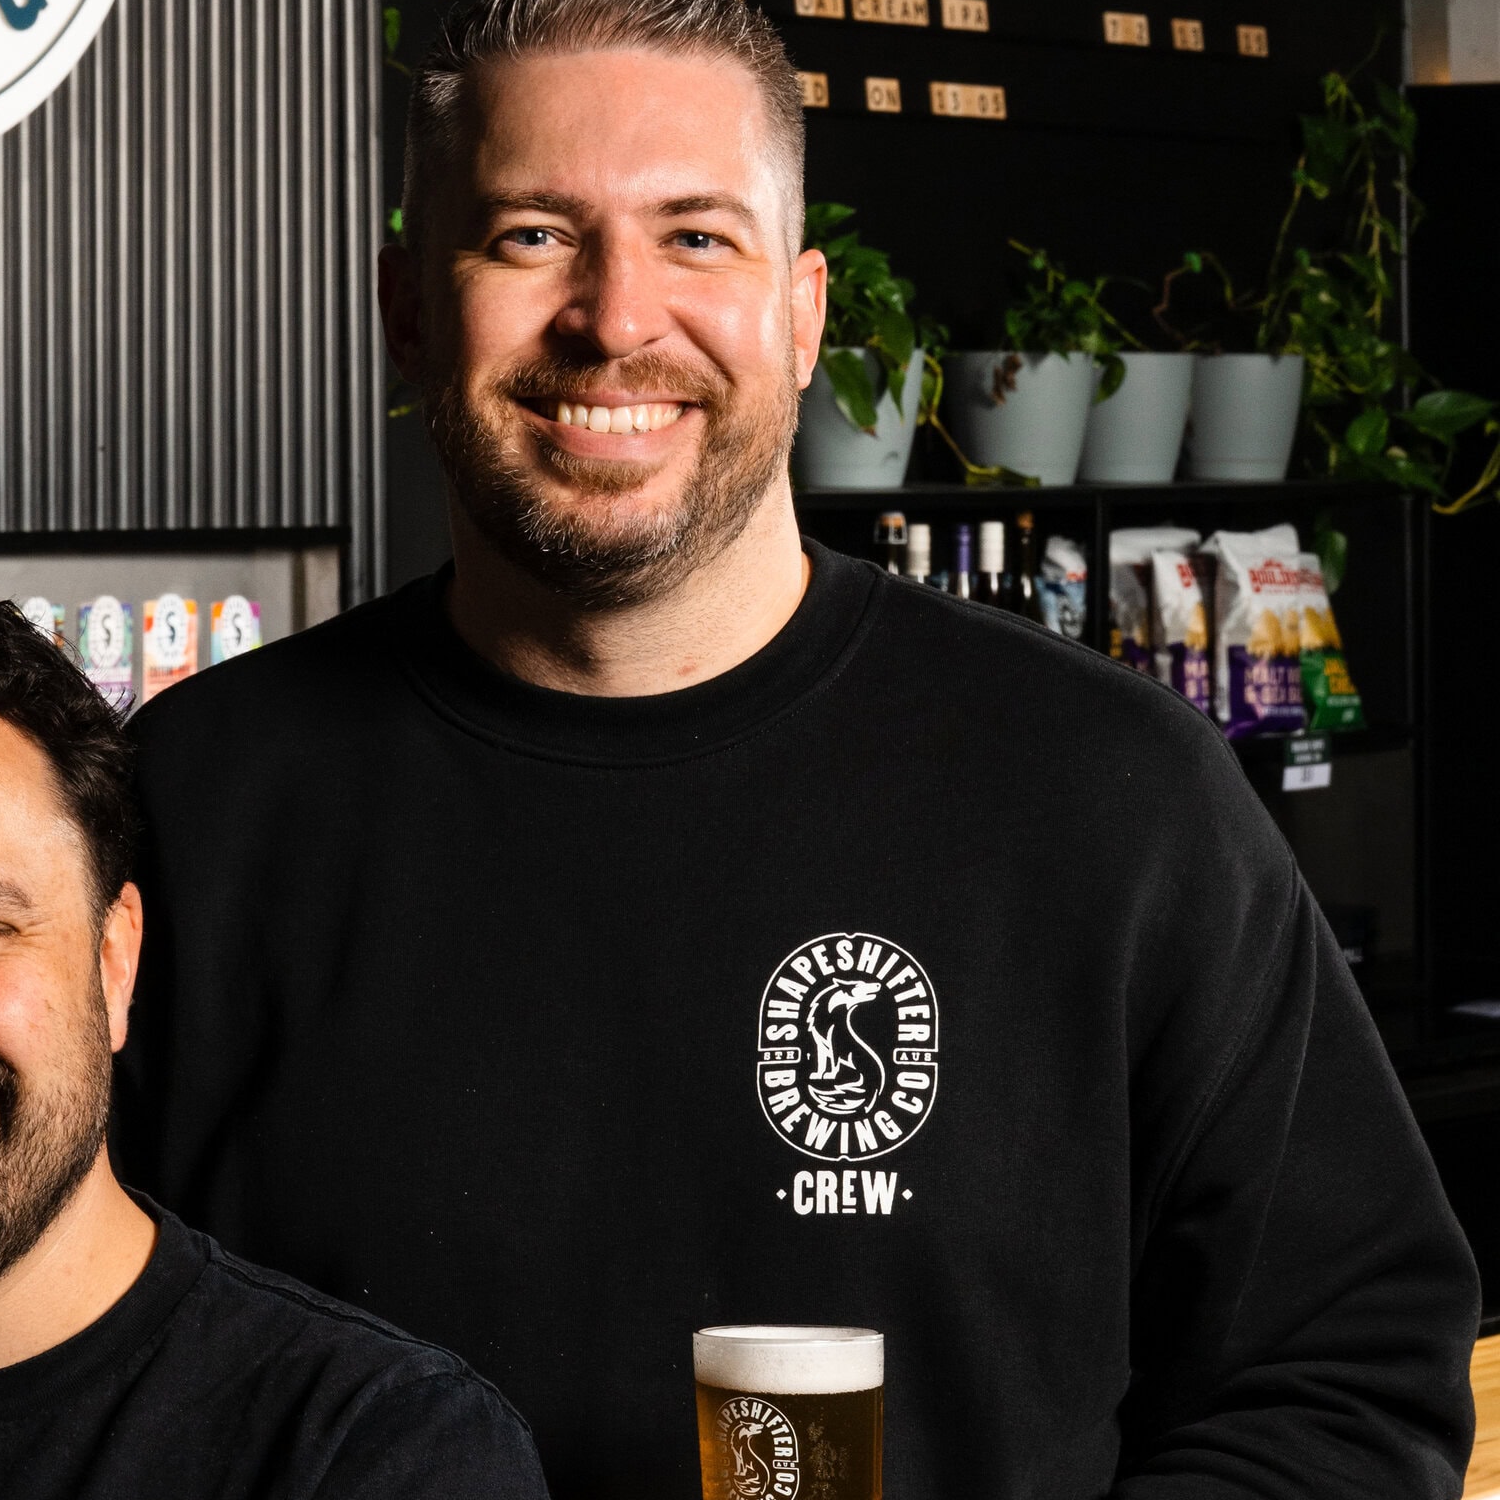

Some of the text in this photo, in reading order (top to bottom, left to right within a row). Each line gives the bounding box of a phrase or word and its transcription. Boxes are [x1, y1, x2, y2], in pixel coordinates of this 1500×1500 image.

[948, 6, 984, 26] IPA
[870, 85, 898, 107] ON
[765, 939, 930, 1042] SHAPESHIFTER
[763, 1051, 795, 1061] STH
[900, 1051, 932, 1062] AUS
[764, 1069, 930, 1154] BREWING CO
[793, 1170, 898, 1216] CREW
[773, 1472, 796, 1496] CO
